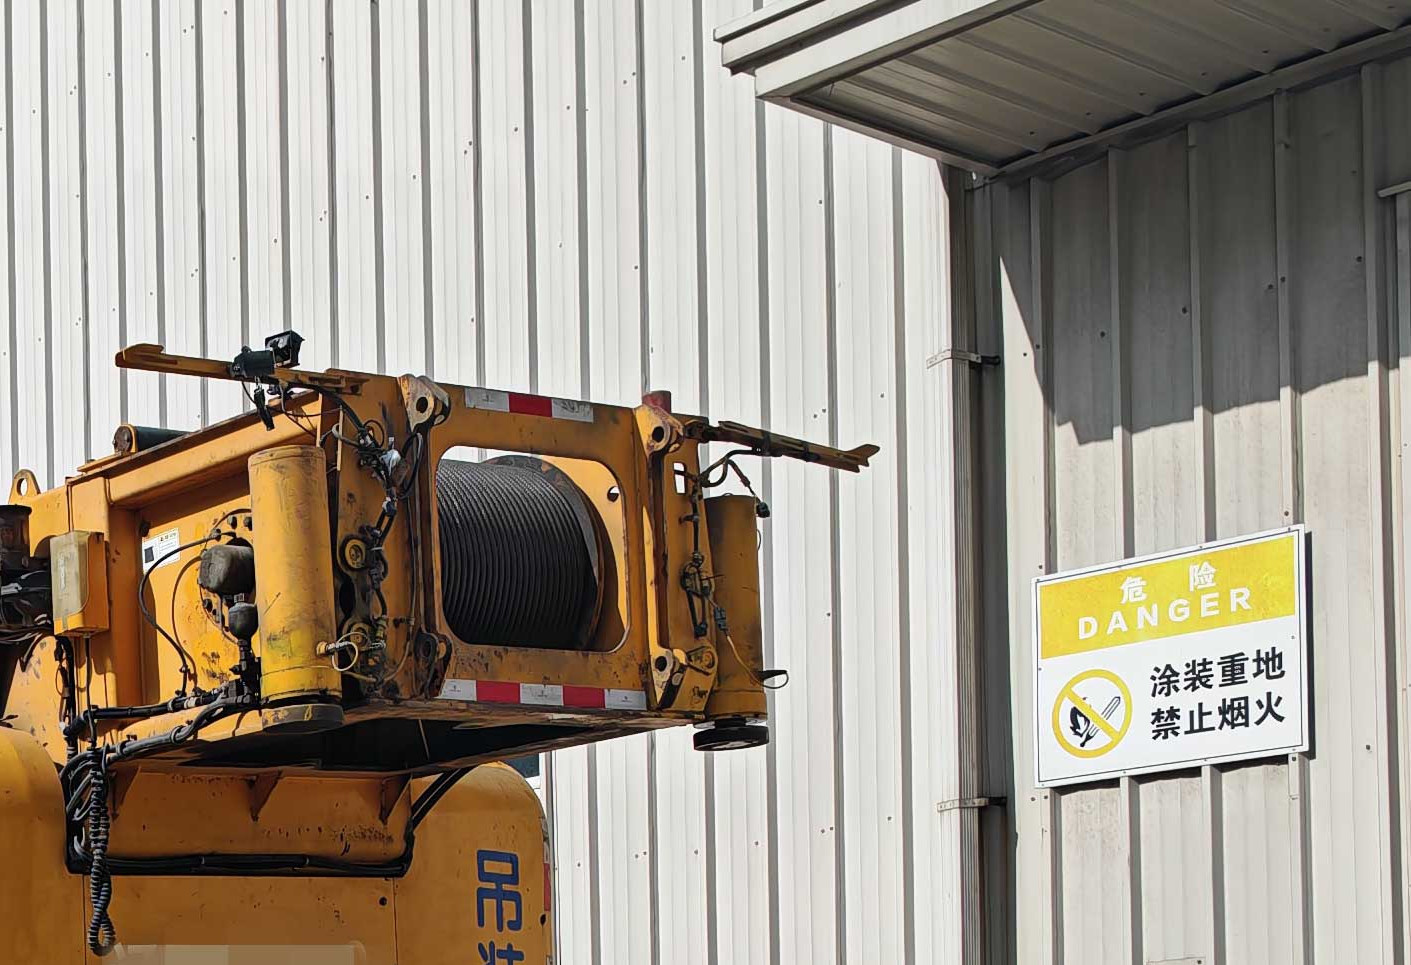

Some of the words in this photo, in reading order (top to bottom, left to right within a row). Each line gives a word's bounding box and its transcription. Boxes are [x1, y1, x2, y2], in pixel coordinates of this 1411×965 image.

[1119, 561, 1219, 606] 危险
[1077, 586, 1254, 641] DANGER
[1149, 645, 1287, 699] 涂装重地
[1150, 691, 1286, 741] 禁止烟火
